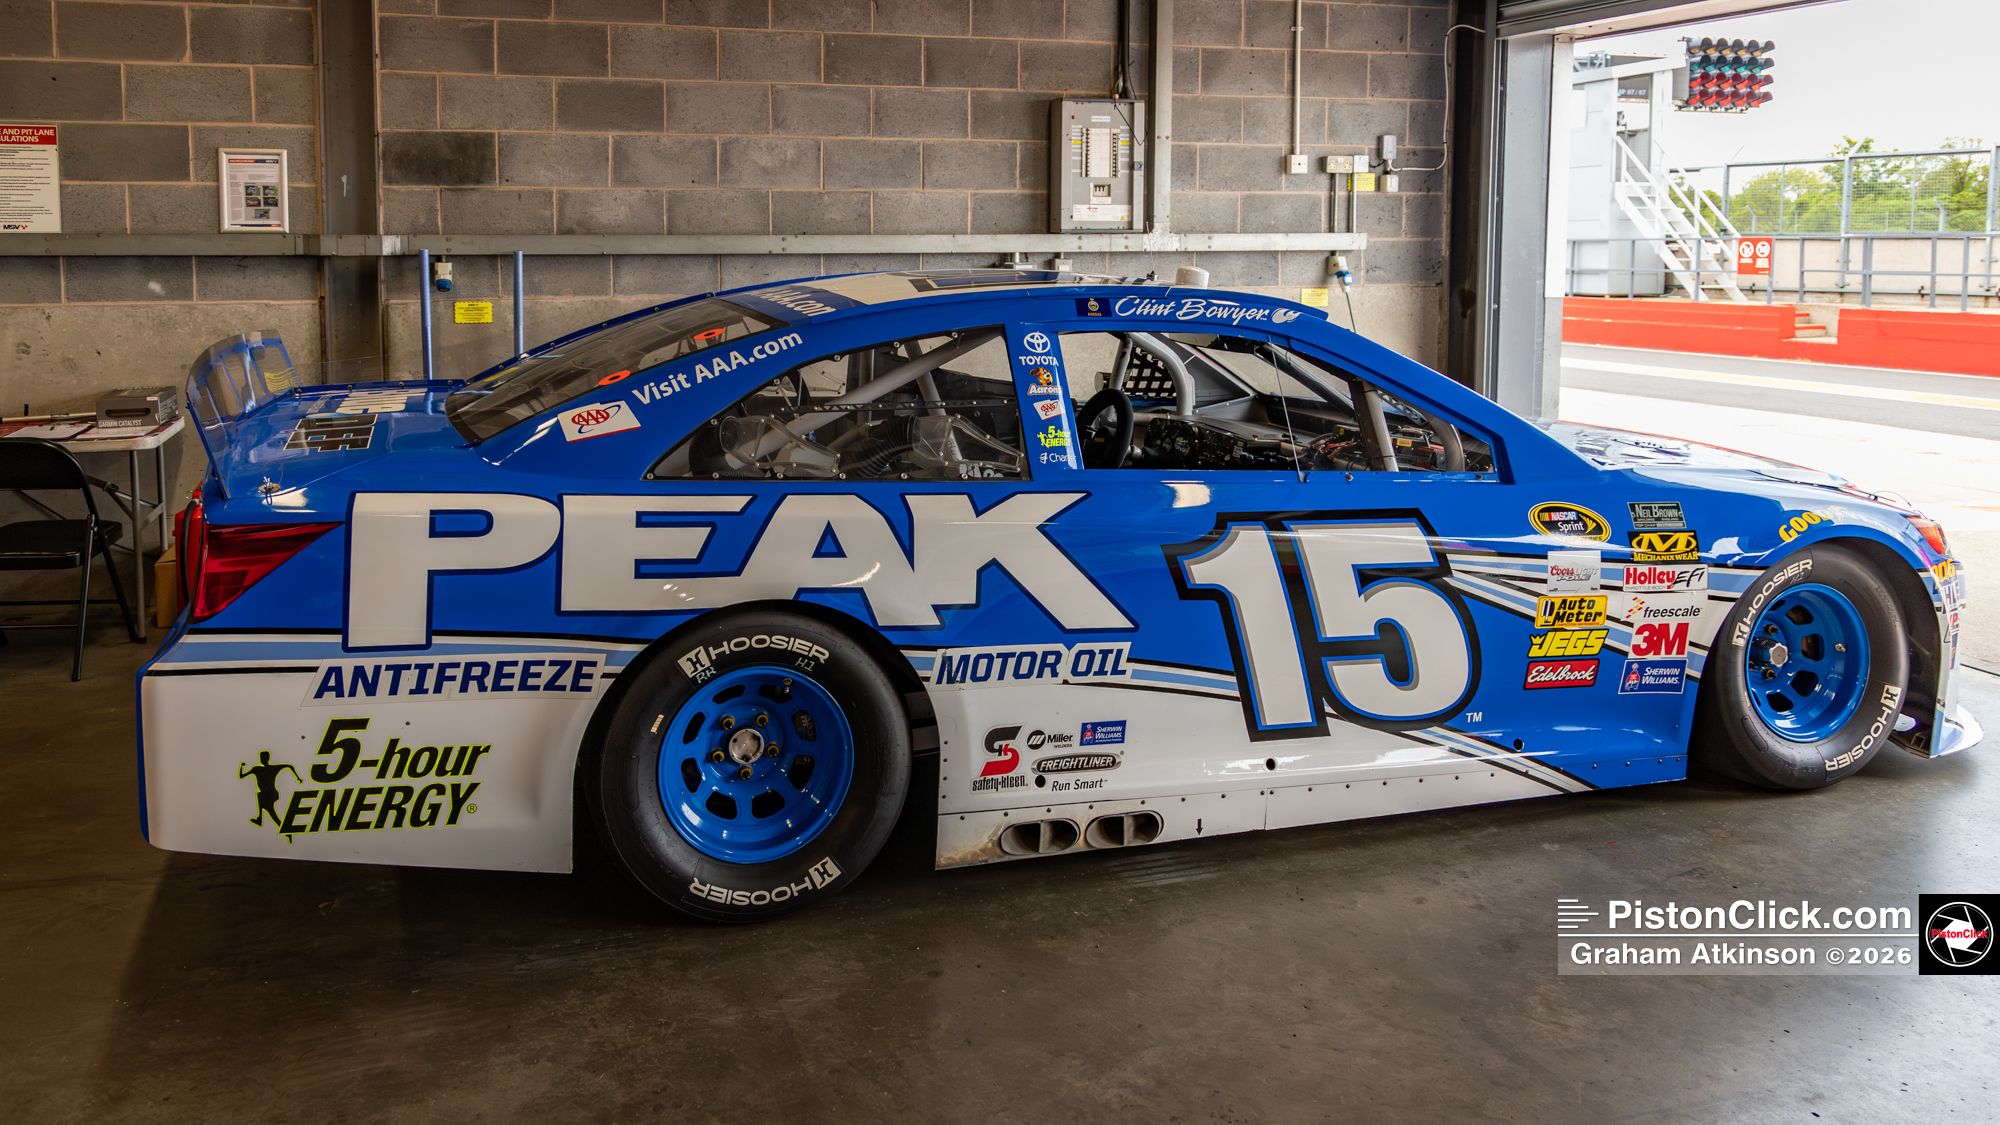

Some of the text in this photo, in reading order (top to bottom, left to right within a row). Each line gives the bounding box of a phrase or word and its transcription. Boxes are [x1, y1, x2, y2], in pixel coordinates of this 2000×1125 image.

[0, 135, 39, 143] ULATIONS
[2, 128, 20, 136] AND
[1114, 295, 1176, 317] Clint
[631, 331, 804, 406] Visit AAA.com
[1019, 355, 1060, 367] TOYOTA
[1029, 384, 1063, 394] Aaron
[98, 420, 118, 428] GARMIN
[573, 409, 609, 426] AAA
[1048, 425, 1072, 438] 5-hour
[1046, 438, 1072, 447] ENERGY
[1551, 511, 1577, 521] NASCAR
[1635, 503, 1679, 518] NEIL BROWN
[1557, 521, 1585, 533] Sprint
[1633, 550, 1699, 562] MECHANIX WEAR
[346, 493, 1135, 648] PEAK
[1550, 564, 1575, 576] Coors
[1625, 567, 1676, 589] Holley
[1742, 558, 1813, 625] HOOSIER
[1557, 597, 1596, 611] Auto
[1552, 610, 1603, 624] Meter
[1643, 606, 1701, 618] freescale
[1181, 522, 1471, 732] 15
[1527, 629, 1609, 658] JEGS
[1631, 622, 1690, 657] 3M
[708, 634, 830, 665] HOOSIER
[935, 648, 1129, 685] MOTOR OIL
[1527, 664, 1594, 683] Edelbrock
[1644, 667, 1681, 676] SHERWIN
[312, 659, 598, 700] ANTIFREEZE
[1047, 733, 1073, 743] Miller
[1824, 706, 1892, 771] HOOSIER
[309, 717, 493, 784] 5-hour
[1039, 756, 1113, 771] FREIGHTLINER
[1051, 778, 1104, 791] Run Smart
[688, 876, 813, 906] HOOSIER
